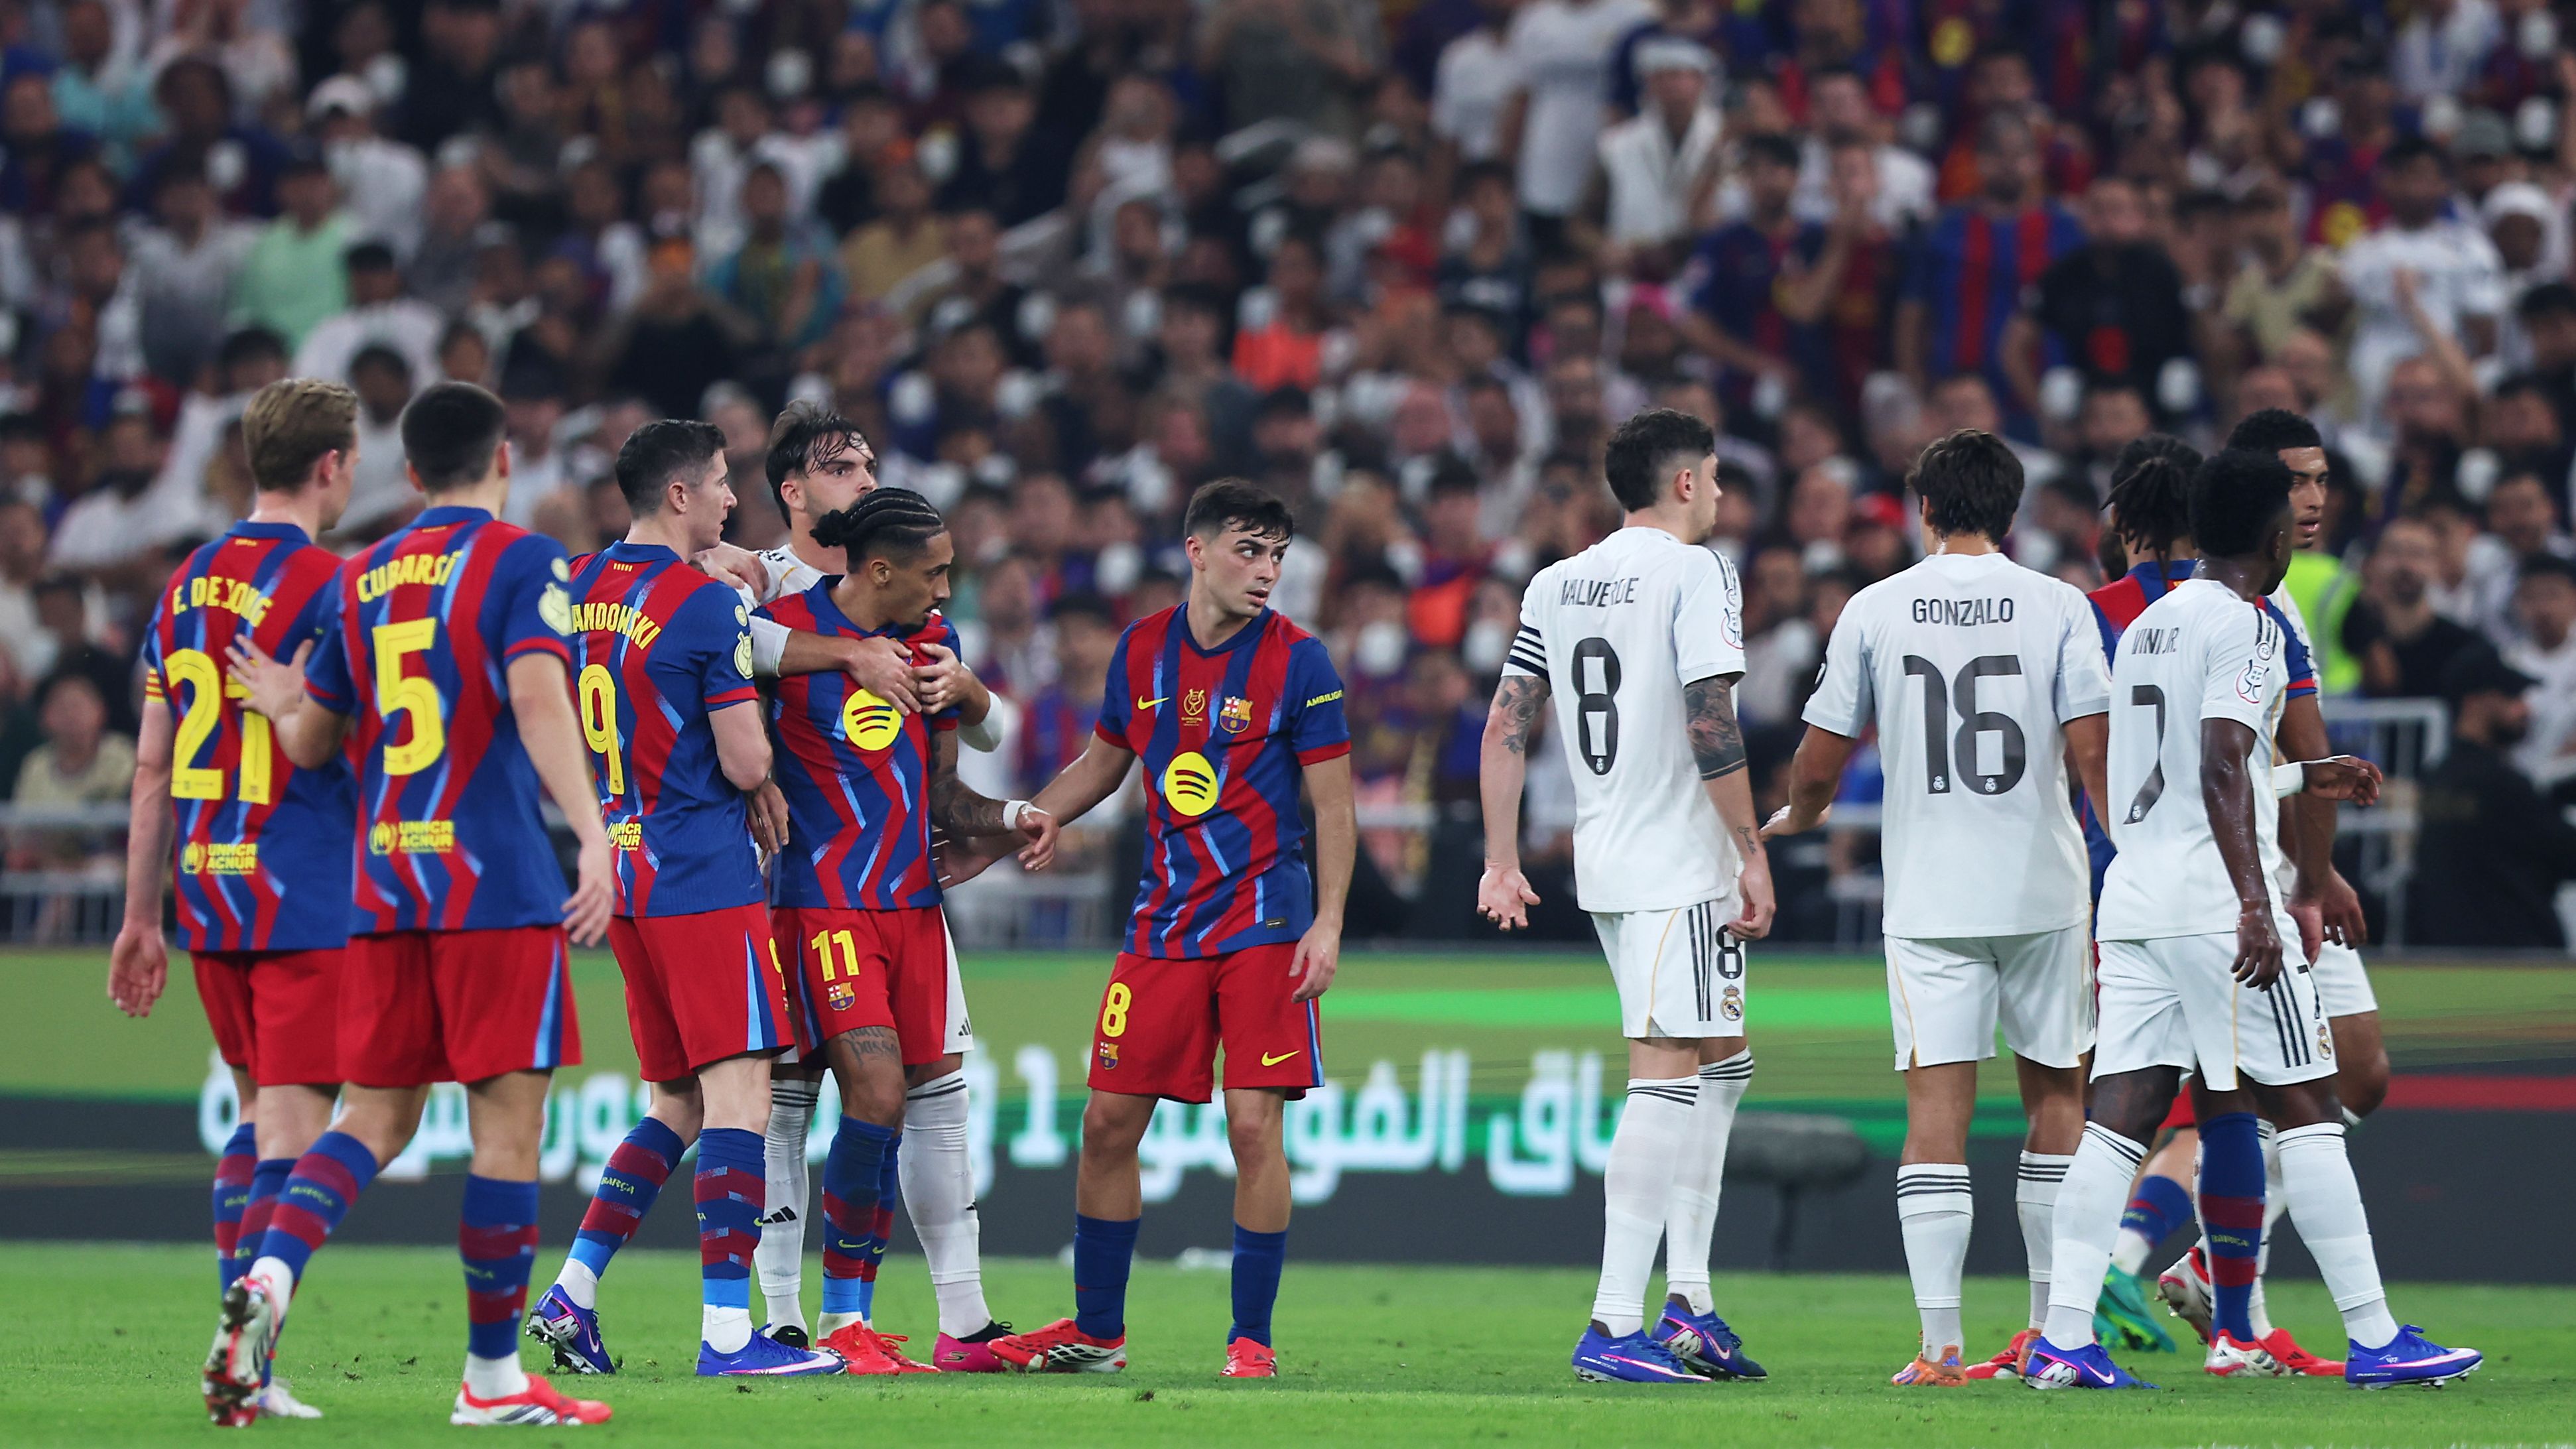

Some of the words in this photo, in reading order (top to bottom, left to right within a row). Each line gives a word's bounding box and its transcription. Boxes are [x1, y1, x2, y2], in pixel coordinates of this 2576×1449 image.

[221, 578, 274, 628] JONG
[1560, 577, 1640, 607] VALVERDE
[1912, 598, 2014, 627] GONZALO
[571, 602, 662, 651] ANDOWSKI
[2131, 628, 2165, 655] VINI
[371, 616, 446, 776] 5
[1571, 637, 1622, 775] 8
[164, 648, 272, 805] 21
[578, 663, 625, 794] 9
[1902, 654, 2026, 796] 16
[2123, 684, 2165, 825] 7
[811, 930, 860, 982] 11
[1715, 924, 1743, 980] 8
[1101, 981, 1131, 1038] 8
[600, 1176, 635, 1194] BARÇA
